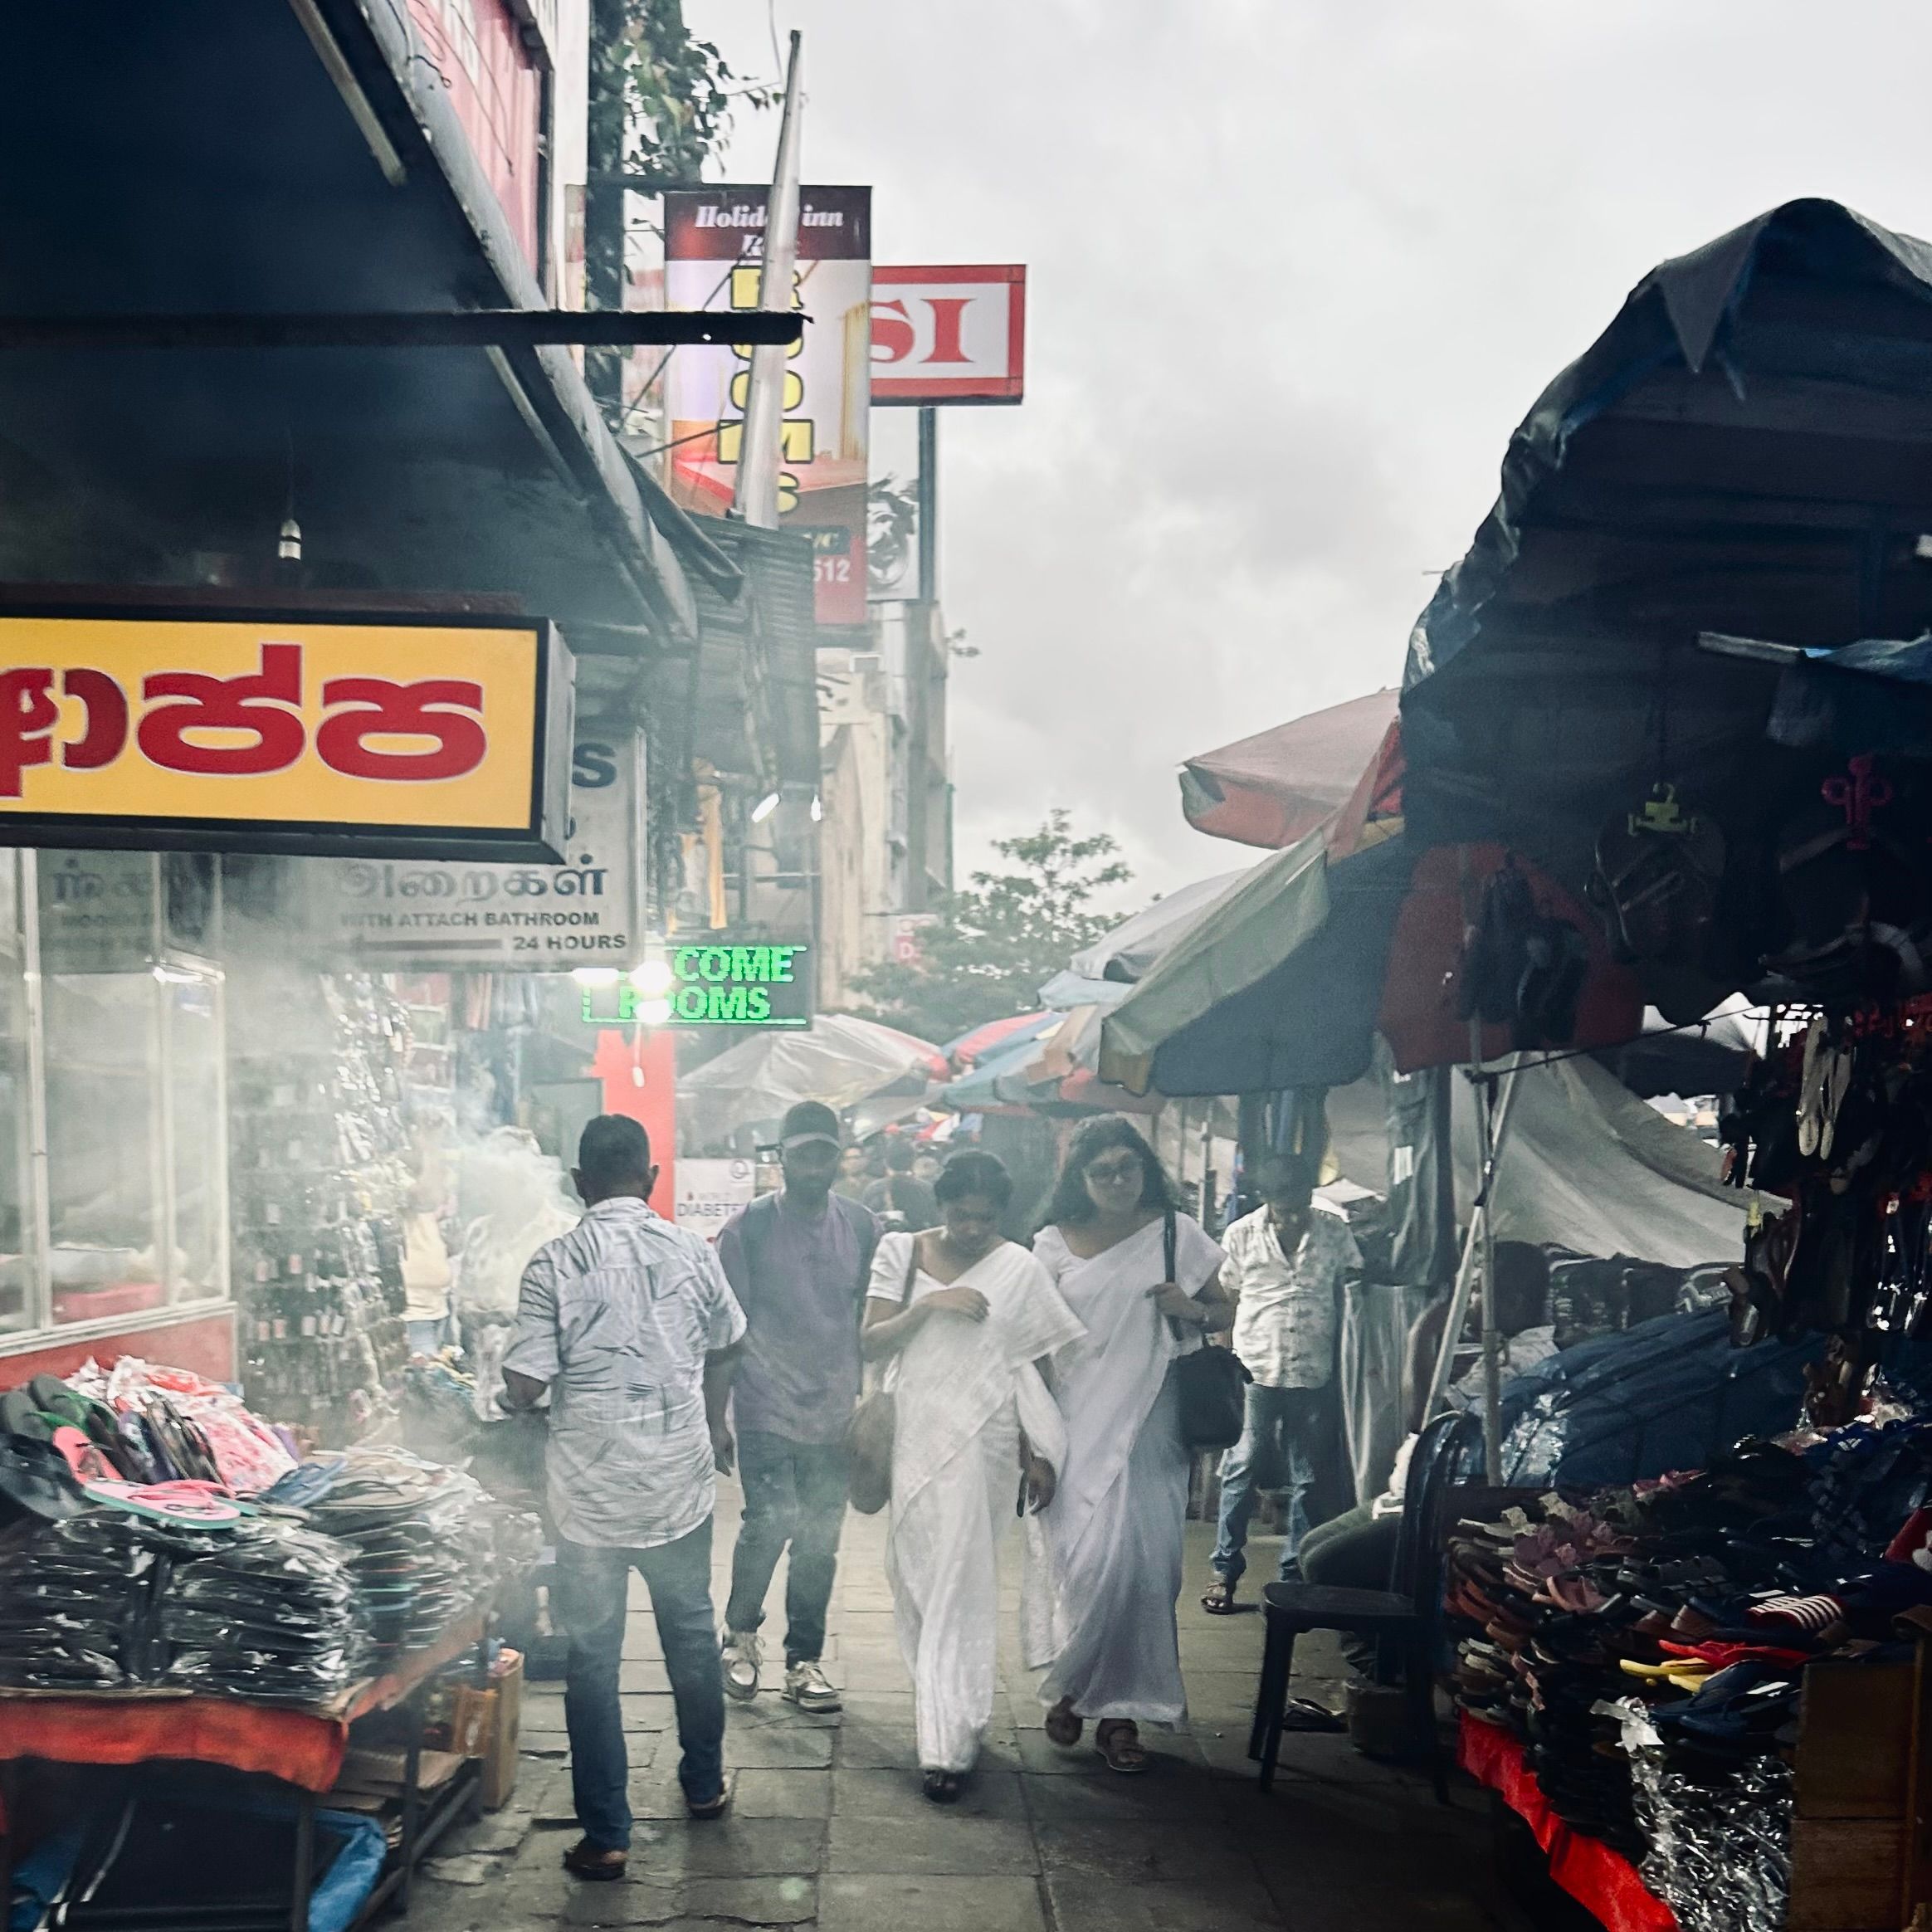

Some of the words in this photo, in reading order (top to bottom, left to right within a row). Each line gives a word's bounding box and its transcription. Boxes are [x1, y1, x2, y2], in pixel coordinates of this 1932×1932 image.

[695, 204, 768, 228] Holid
[801, 204, 844, 227] inn
[398, 913, 478, 927] ATTACH
[485, 912, 599, 926] BATHROOM
[513, 936, 539, 949] 24
[548, 934, 627, 949] HOURS
